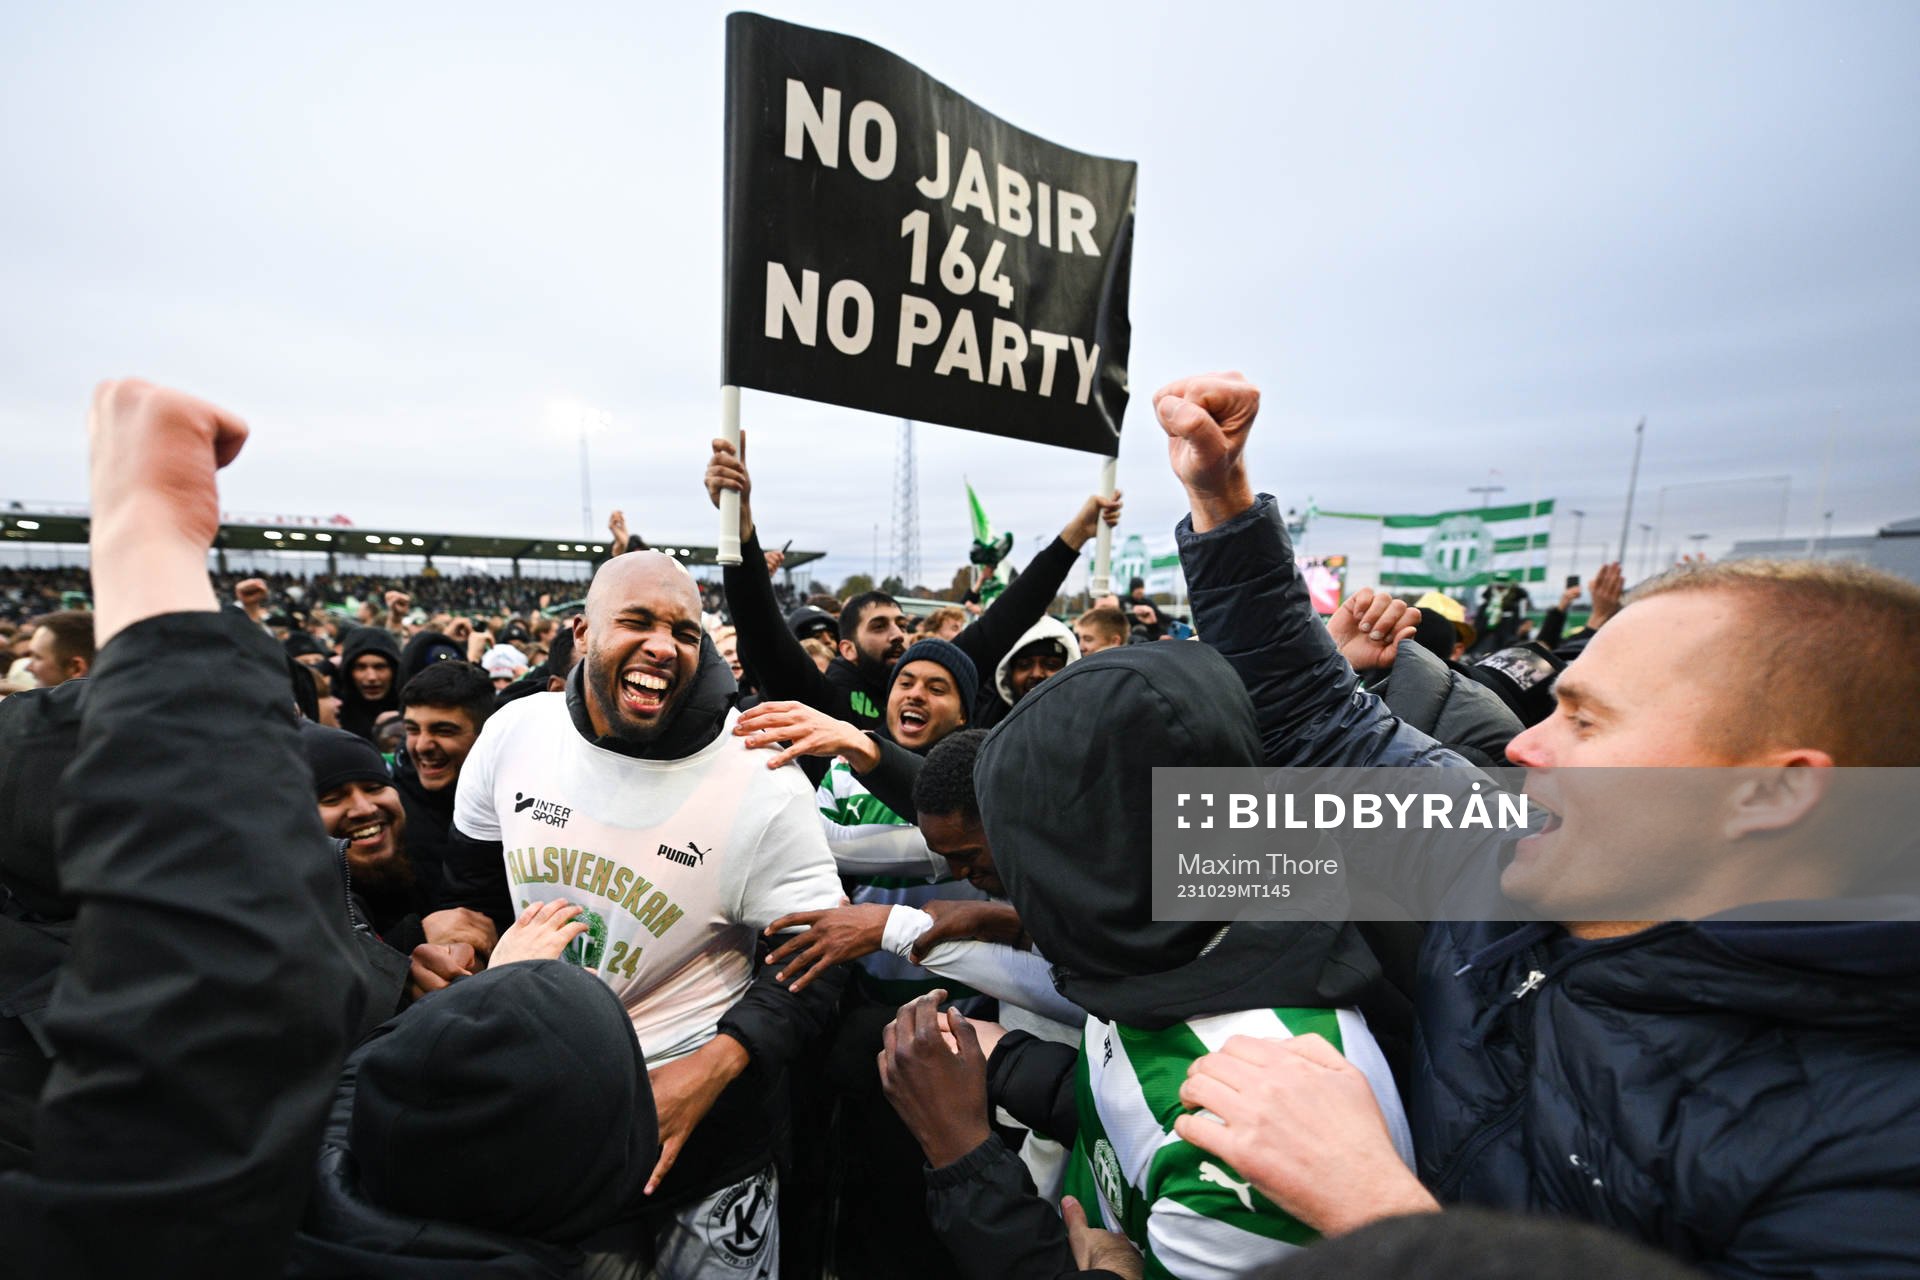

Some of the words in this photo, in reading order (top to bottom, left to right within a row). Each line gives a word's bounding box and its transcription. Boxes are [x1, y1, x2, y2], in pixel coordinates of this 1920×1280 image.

[785, 78, 897, 181] NO
[916, 130, 1101, 256] JABIR
[901, 209, 1014, 308] 164
[765, 261, 875, 355] NO
[896, 293, 1100, 405] PARTY
[531, 809, 568, 829] SPORT
[535, 799, 571, 818] INTER
[657, 844, 697, 868] PUMA
[507, 847, 684, 939] ALLSVENSKAN
[607, 941, 643, 979] 24
